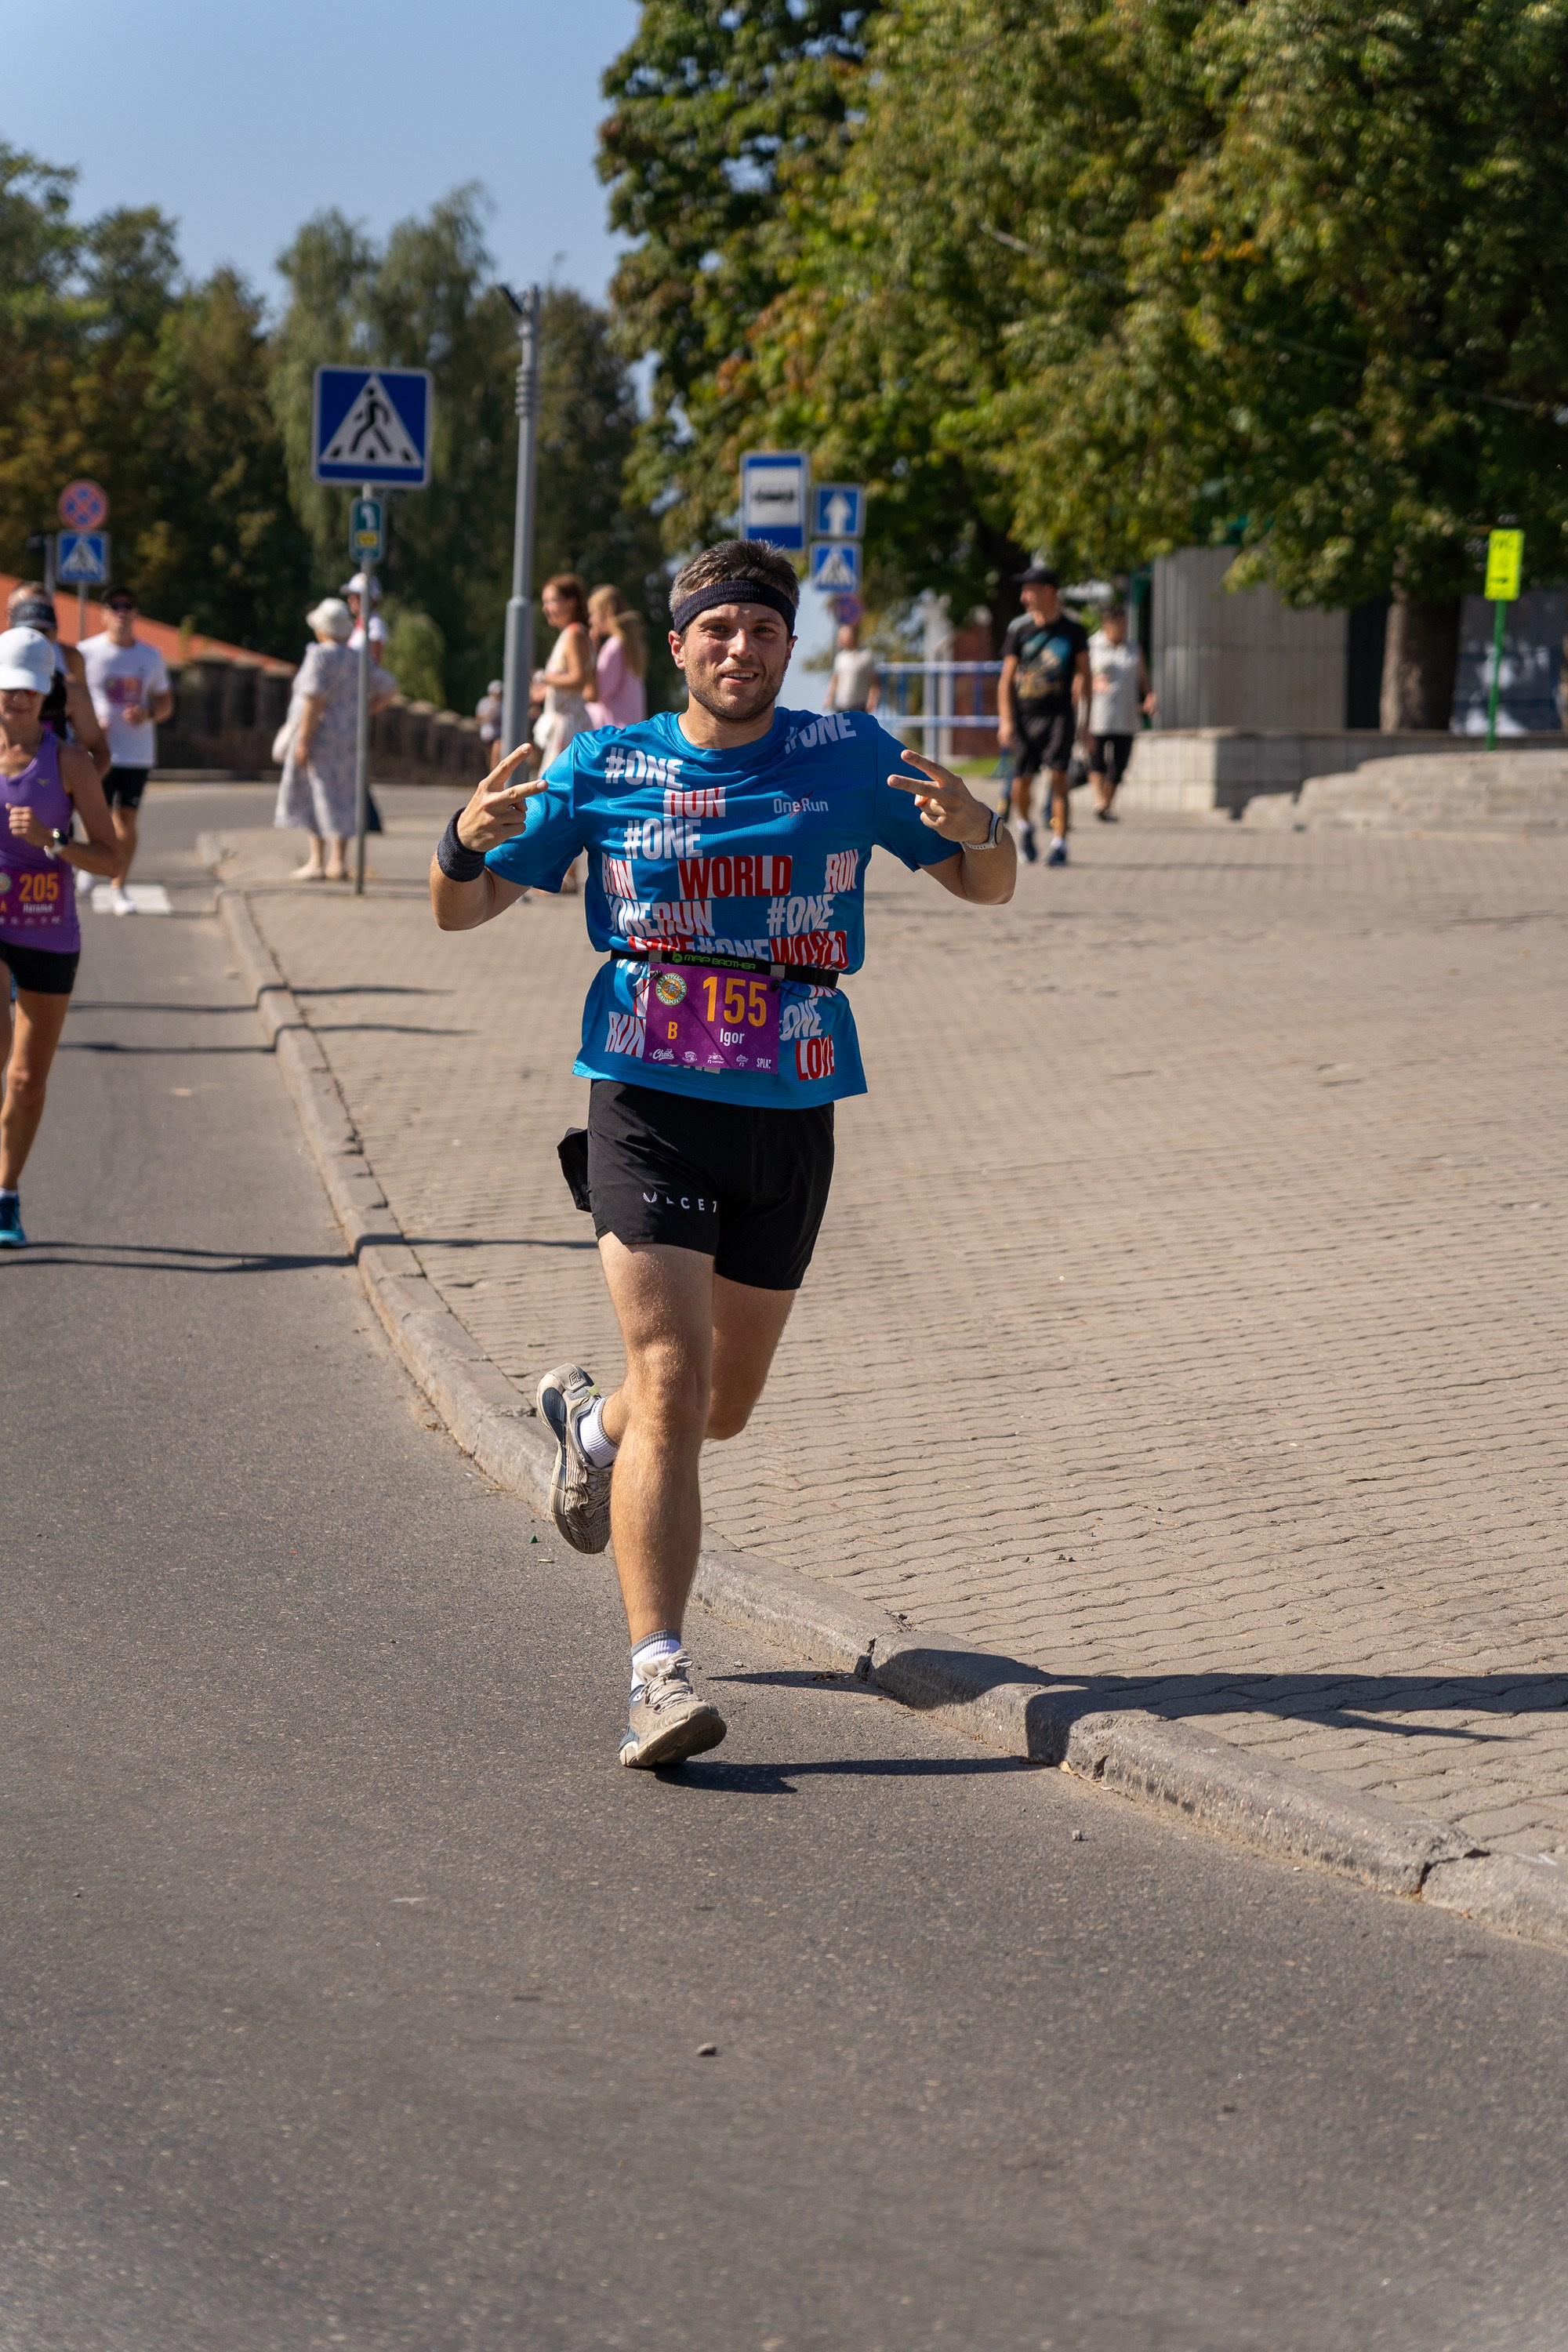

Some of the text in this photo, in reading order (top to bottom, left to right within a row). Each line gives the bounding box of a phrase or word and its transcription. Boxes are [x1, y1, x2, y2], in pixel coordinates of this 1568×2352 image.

[604, 747, 683, 789] #ONE
[773, 798, 829, 814] OneRun
[622, 818, 703, 860] #ONE
[19, 873, 59, 902] 205
[602, 852, 637, 900] RUN
[677, 855, 793, 901] WORLD
[823, 849, 859, 893] RUN
[766, 894, 836, 936] #ONE
[702, 976, 768, 1027] 155
[779, 997, 823, 1040] ONE
[604, 1011, 646, 1058] RUN
[667, 1022, 678, 1040] B
[720, 1028, 744, 1047] Igor
